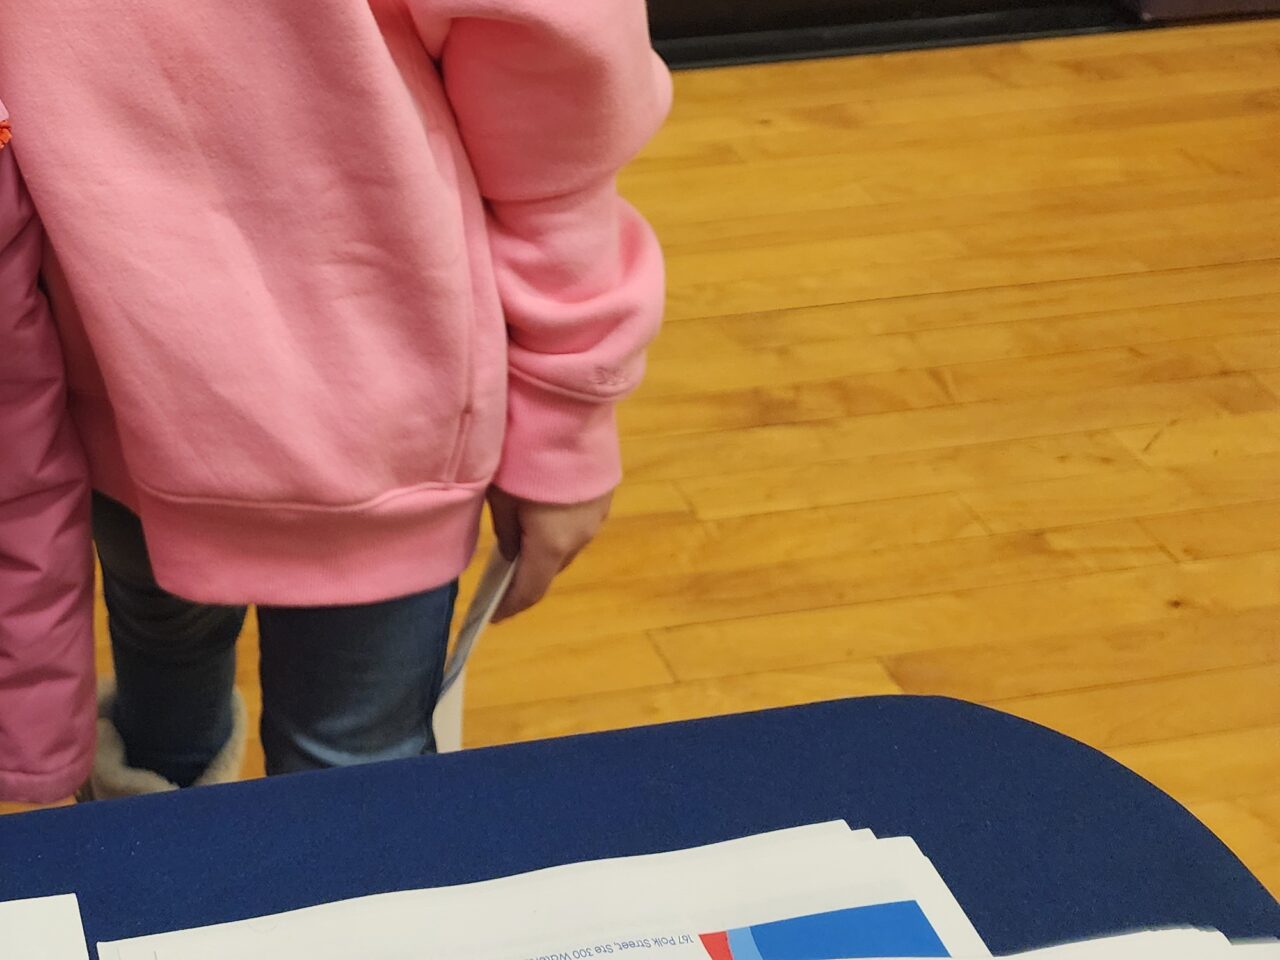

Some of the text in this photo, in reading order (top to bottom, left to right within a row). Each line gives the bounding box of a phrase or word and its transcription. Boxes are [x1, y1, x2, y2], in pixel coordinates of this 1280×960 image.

[613, 939, 652, 951] Street,
[653, 936, 676, 947] Polk
[678, 934, 694, 945] 167
[572, 949, 594, 959] 300
[594, 944, 614, 954] Ste
